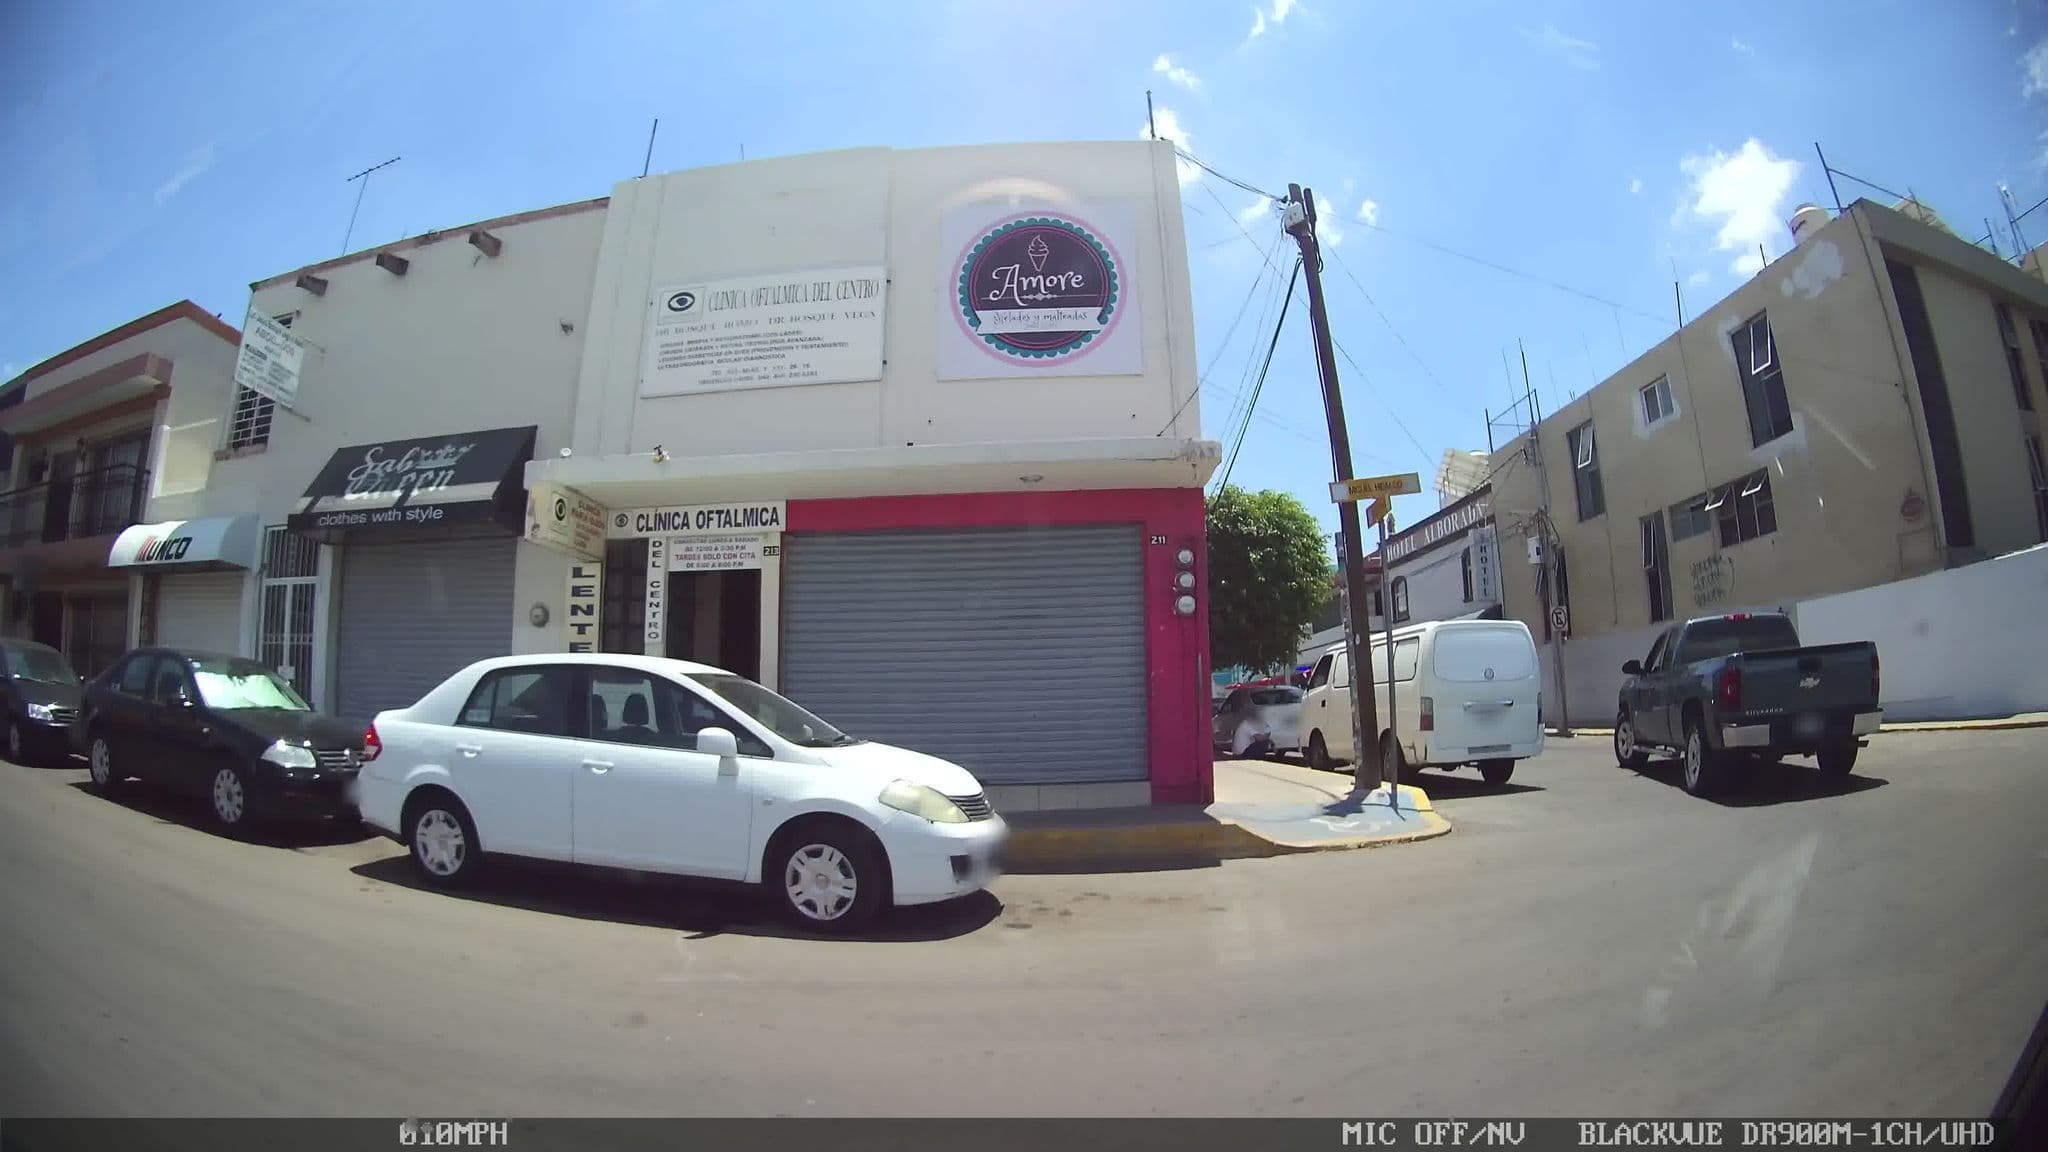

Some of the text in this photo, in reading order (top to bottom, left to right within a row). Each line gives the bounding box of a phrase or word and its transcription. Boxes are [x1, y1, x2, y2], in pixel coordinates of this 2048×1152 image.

[812, 281, 832, 302] DEL
[837, 279, 880, 301] CENTRO
[989, 263, 1085, 306] Amore
[319, 507, 443, 528] clothes with style
[696, 506, 780, 529] OFTALMICA
[1151, 536, 1166, 545] 211
[1386, 501, 1485, 563] HOTEL ALBORADA
[652, 541, 663, 568] DEL
[723, 552, 737, 560] CON
[740, 552, 756, 560] CITA
[764, 547, 780, 556] 213
[648, 581, 662, 640] CENTRO
